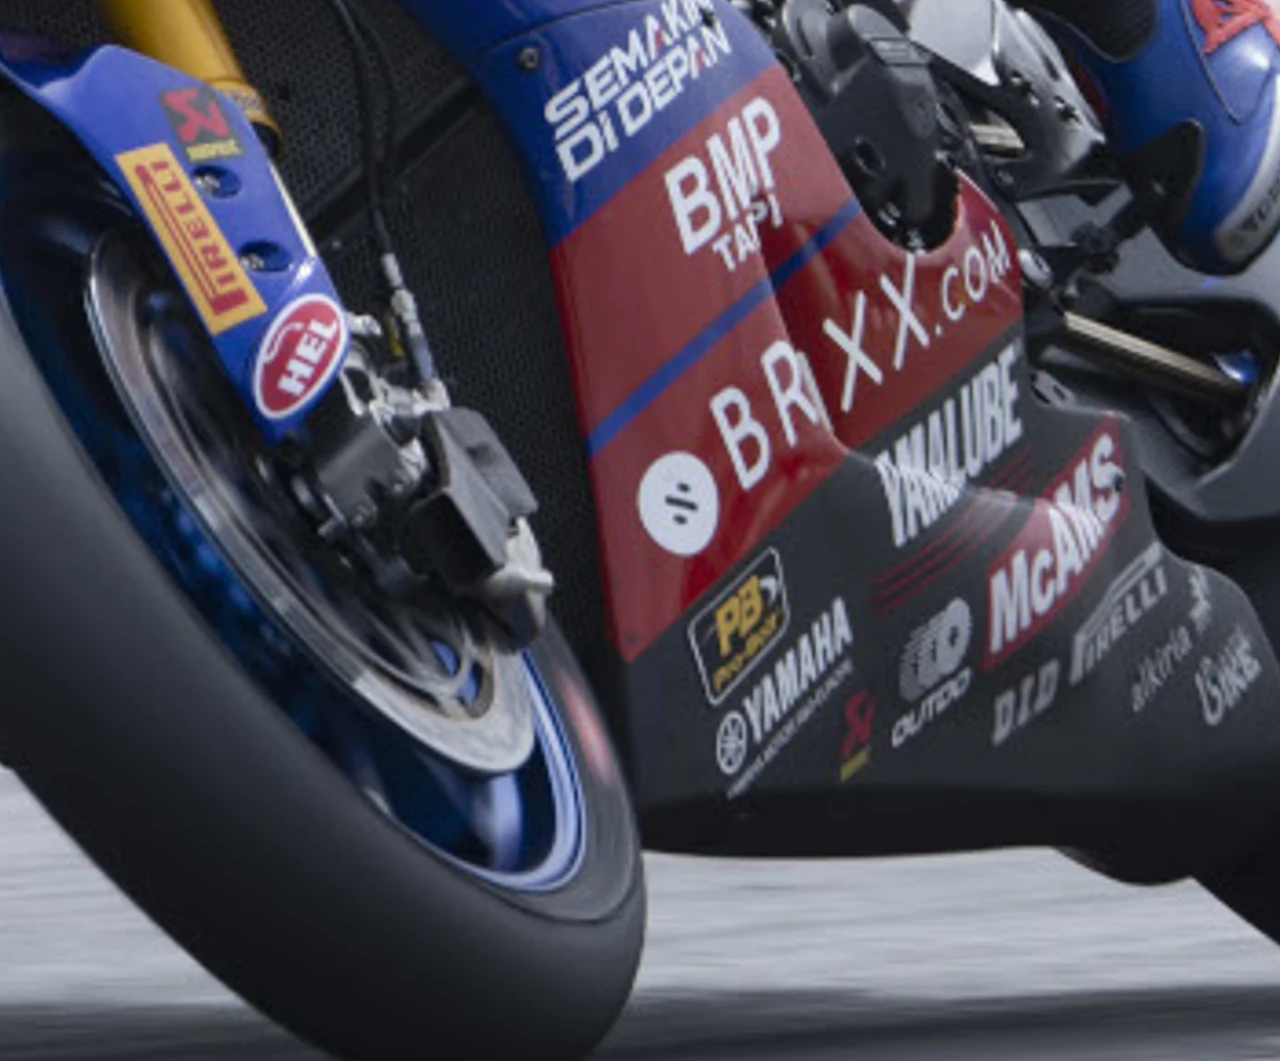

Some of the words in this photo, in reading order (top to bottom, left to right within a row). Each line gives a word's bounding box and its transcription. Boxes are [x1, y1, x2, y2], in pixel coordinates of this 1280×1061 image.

[555, 111, 616, 182] DI
[618, 24, 732, 137] DEPAN
[664, 97, 781, 255] BMP
[134, 159, 250, 318] PIRELLI
[279, 317, 337, 397] HEL
[874, 342, 1024, 547] YAMALUBE
[715, 575, 764, 657] PB
[987, 433, 1123, 654] McAMS
[742, 597, 853, 742] YAMAHA
